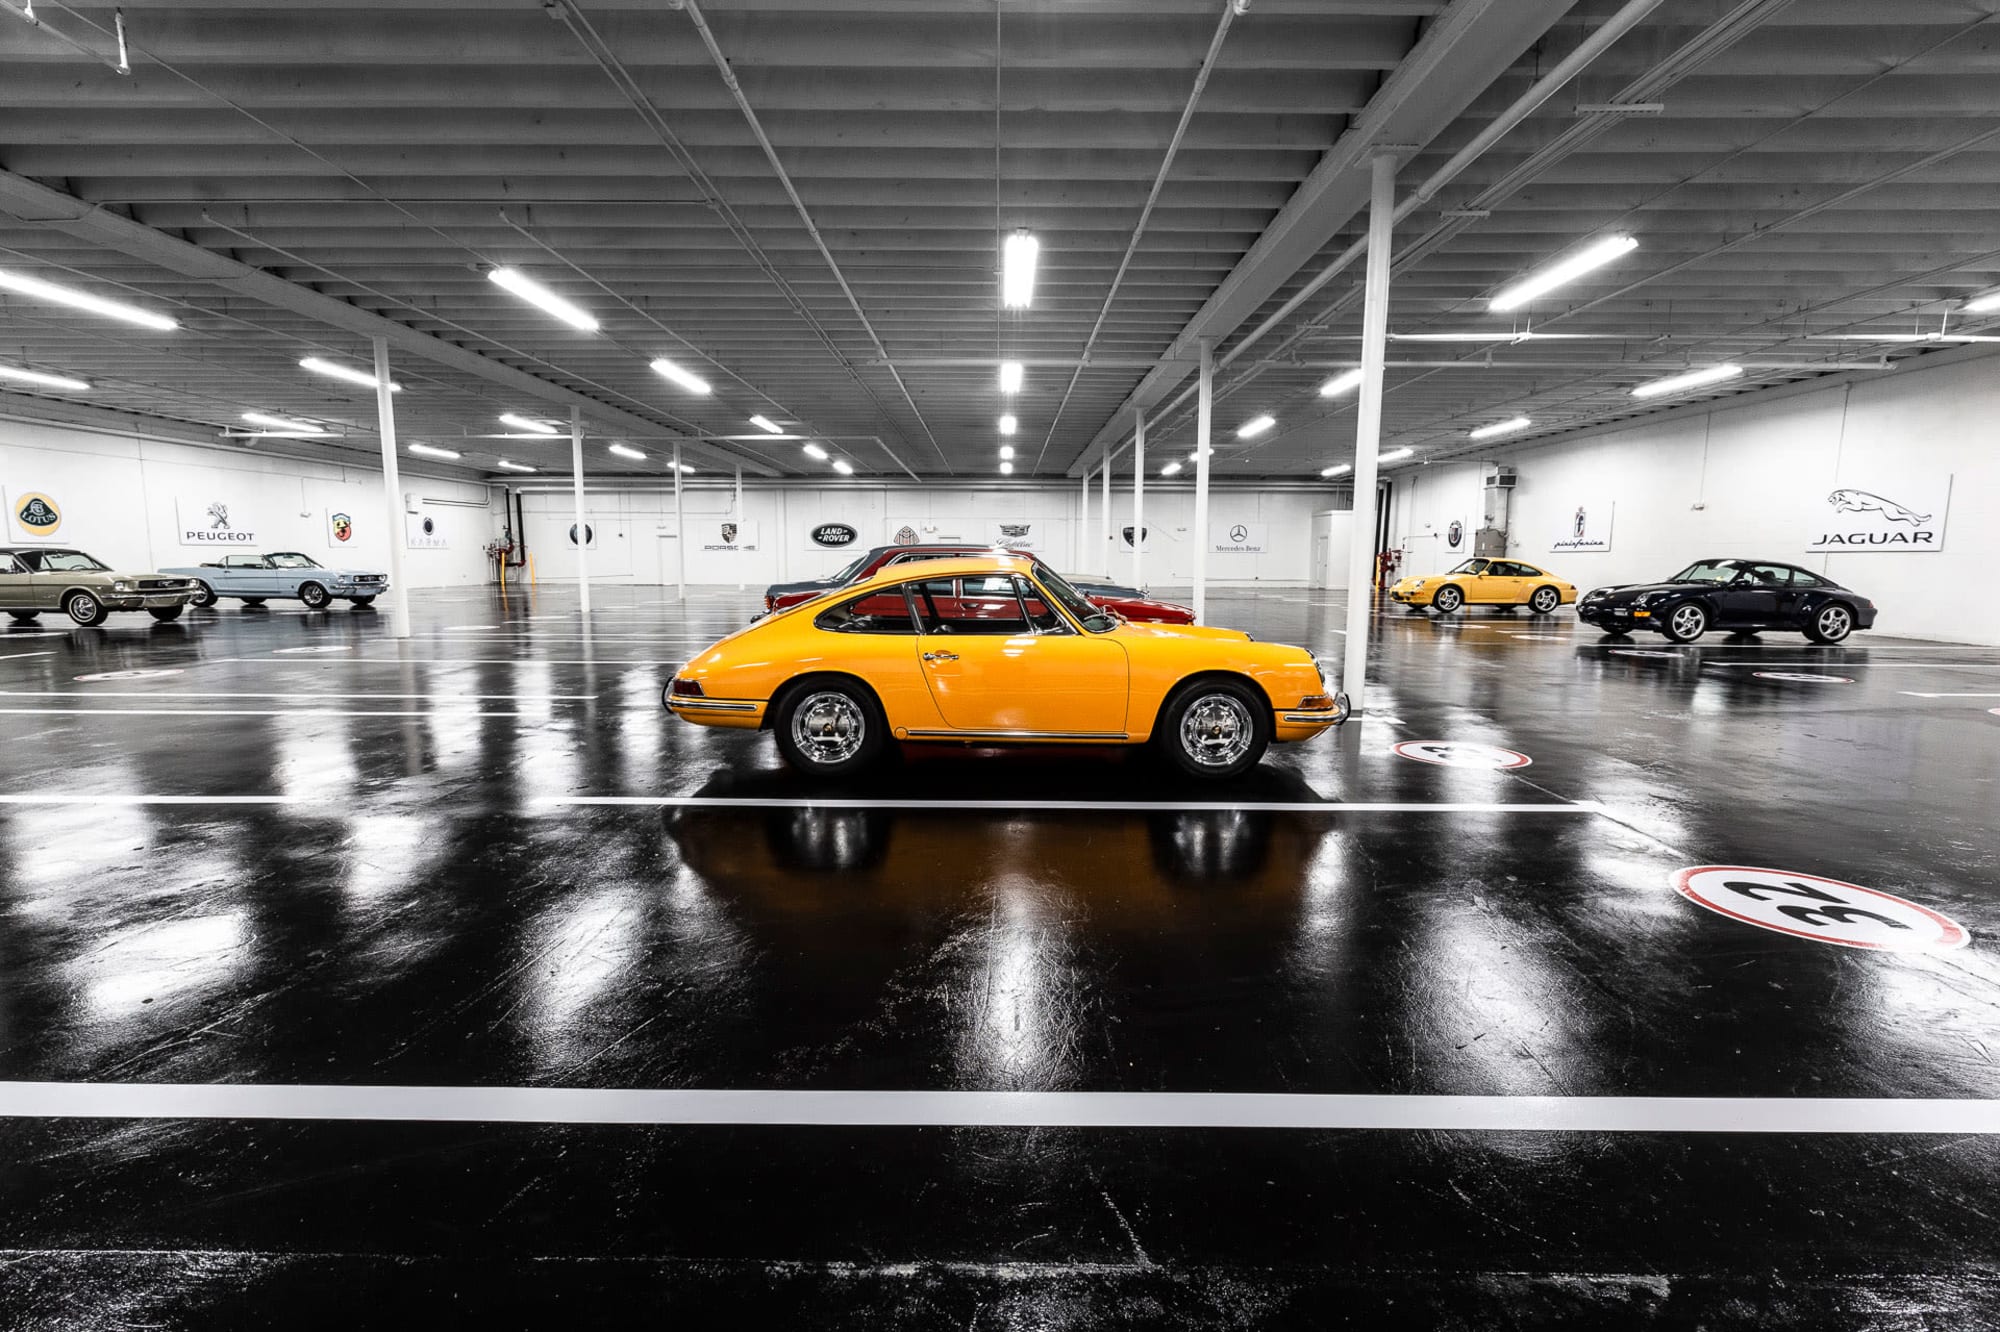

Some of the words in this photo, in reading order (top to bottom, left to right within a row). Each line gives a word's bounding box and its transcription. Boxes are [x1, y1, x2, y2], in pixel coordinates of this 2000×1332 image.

[22, 511, 56, 523] LOTUS
[186, 531, 255, 541] PEUGEOT
[1811, 531, 1934, 545] JAGUAR
